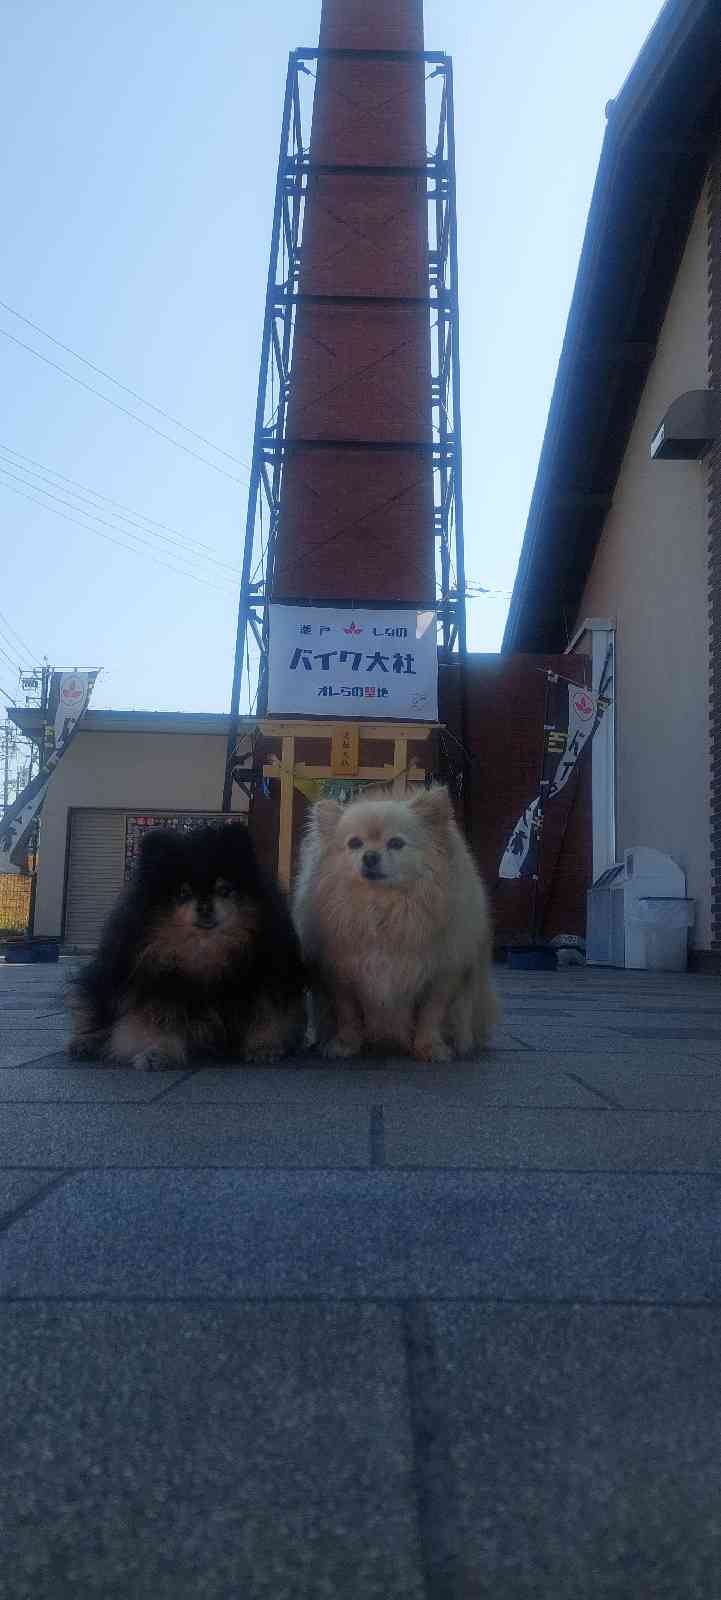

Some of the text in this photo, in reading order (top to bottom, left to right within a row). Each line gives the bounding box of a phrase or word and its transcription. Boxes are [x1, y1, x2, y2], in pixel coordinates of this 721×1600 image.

[289, 648, 417, 675] バイク大社
